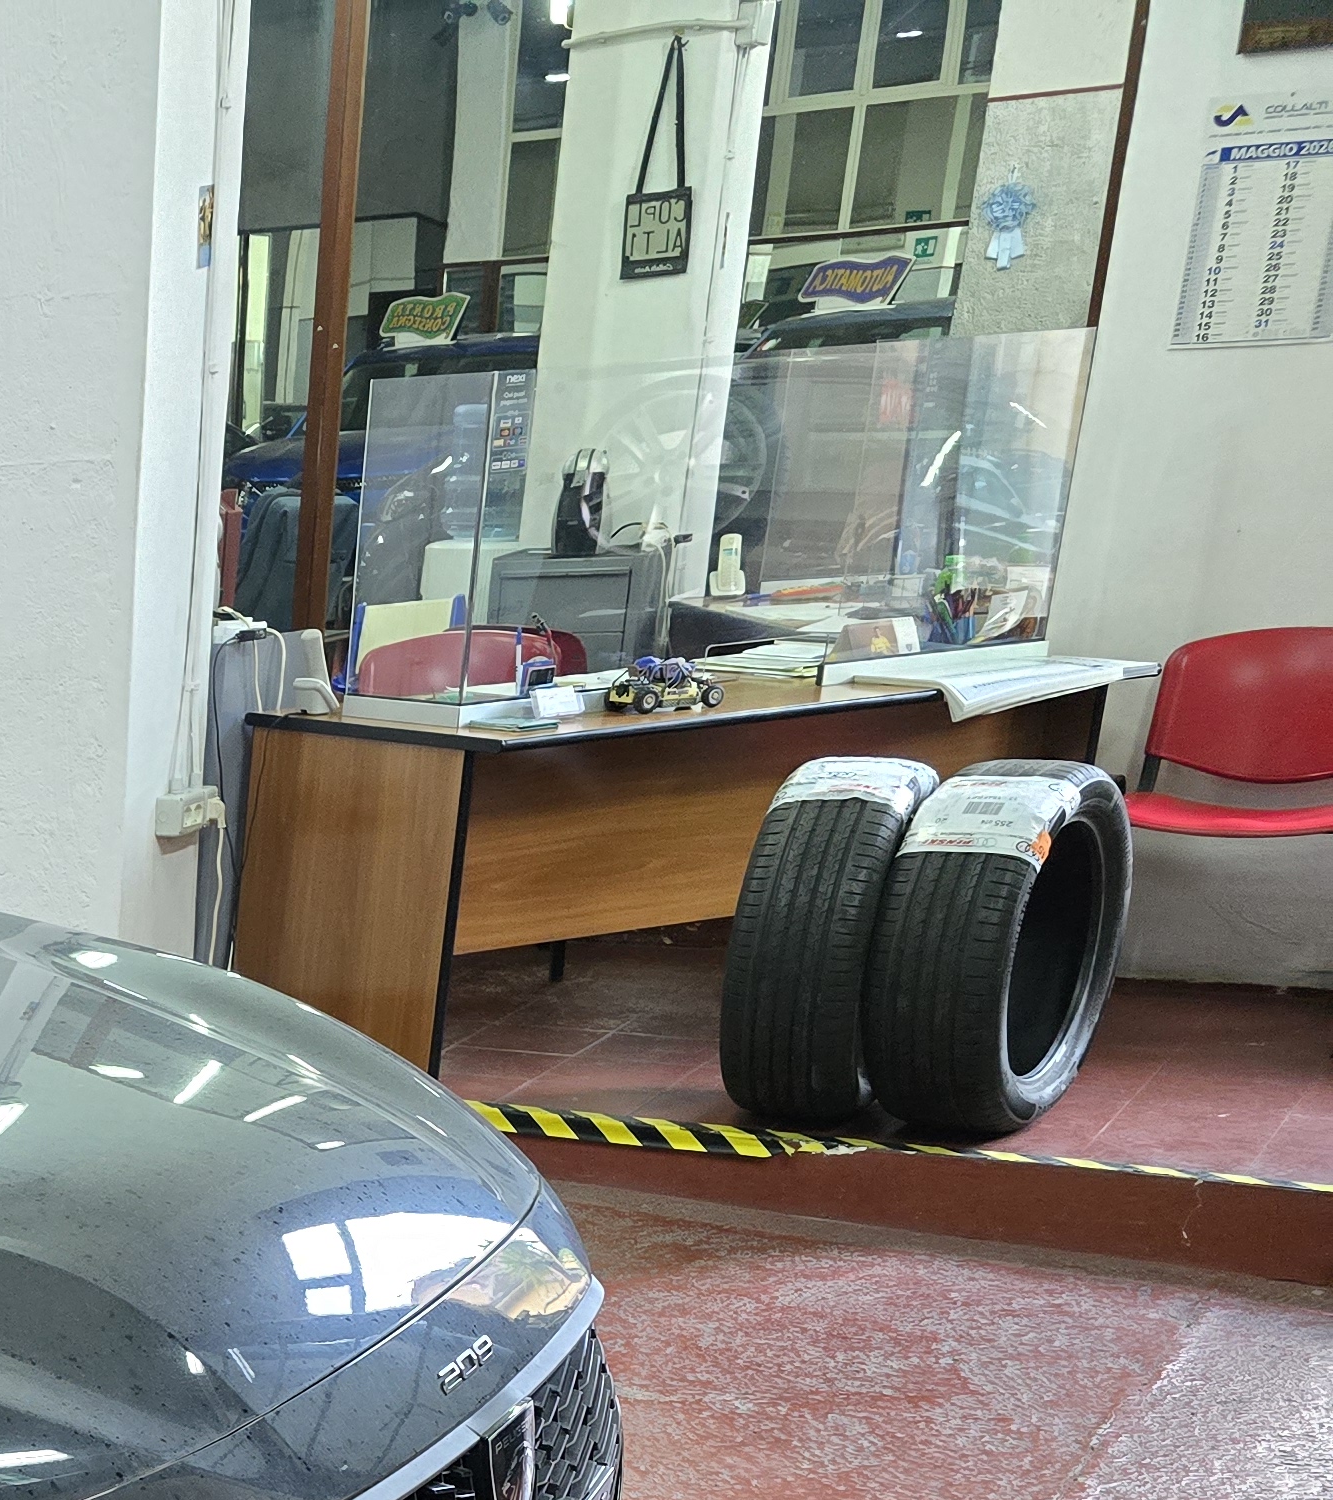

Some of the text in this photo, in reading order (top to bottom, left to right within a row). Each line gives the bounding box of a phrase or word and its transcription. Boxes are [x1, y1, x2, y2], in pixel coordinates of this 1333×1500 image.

[1264, 100, 1329, 115] COLLALTI
[1230, 142, 1299, 161] MAGGIO
[1232, 164, 1238, 174] 1
[1284, 160, 1300, 170] 17
[1229, 176, 1238, 186] 2
[1283, 171, 1298, 181] 18
[1227, 187, 1236, 197] 3
[1280, 183, 1296, 193] 19
[1224, 199, 1233, 208] 4
[1276, 194, 1294, 205] 20
[1223, 210, 1232, 220] 5
[1274, 206, 1290, 216] 21
[1221, 221, 1230, 231] 6
[1272, 217, 1290, 228] 22
[1219, 232, 1228, 242] 7
[1270, 228, 1287, 239] 23
[1217, 243, 1226, 253] 8
[1268, 240, 1285, 251] 24
[1215, 254, 1224, 265] 9
[1266, 251, 1283, 262] 25
[1207, 266, 1222, 276] 10
[1264, 262, 1282, 273] 26
[1205, 277, 1218, 287] 11
[1262, 274, 1280, 284] 27
[1203, 288, 1218, 298] 12
[1260, 285, 1277, 295] 28
[1201, 299, 1215, 309] 13
[1258, 296, 1275, 307] 29
[1199, 310, 1214, 320] 14
[1256, 307, 1273, 318] 30
[1197, 321, 1211, 331] 15
[1254, 318, 1270, 329] 31
[1195, 332, 1210, 343] 16
[506, 374, 526, 384] nexi
[994, 819, 1014, 828] 255
